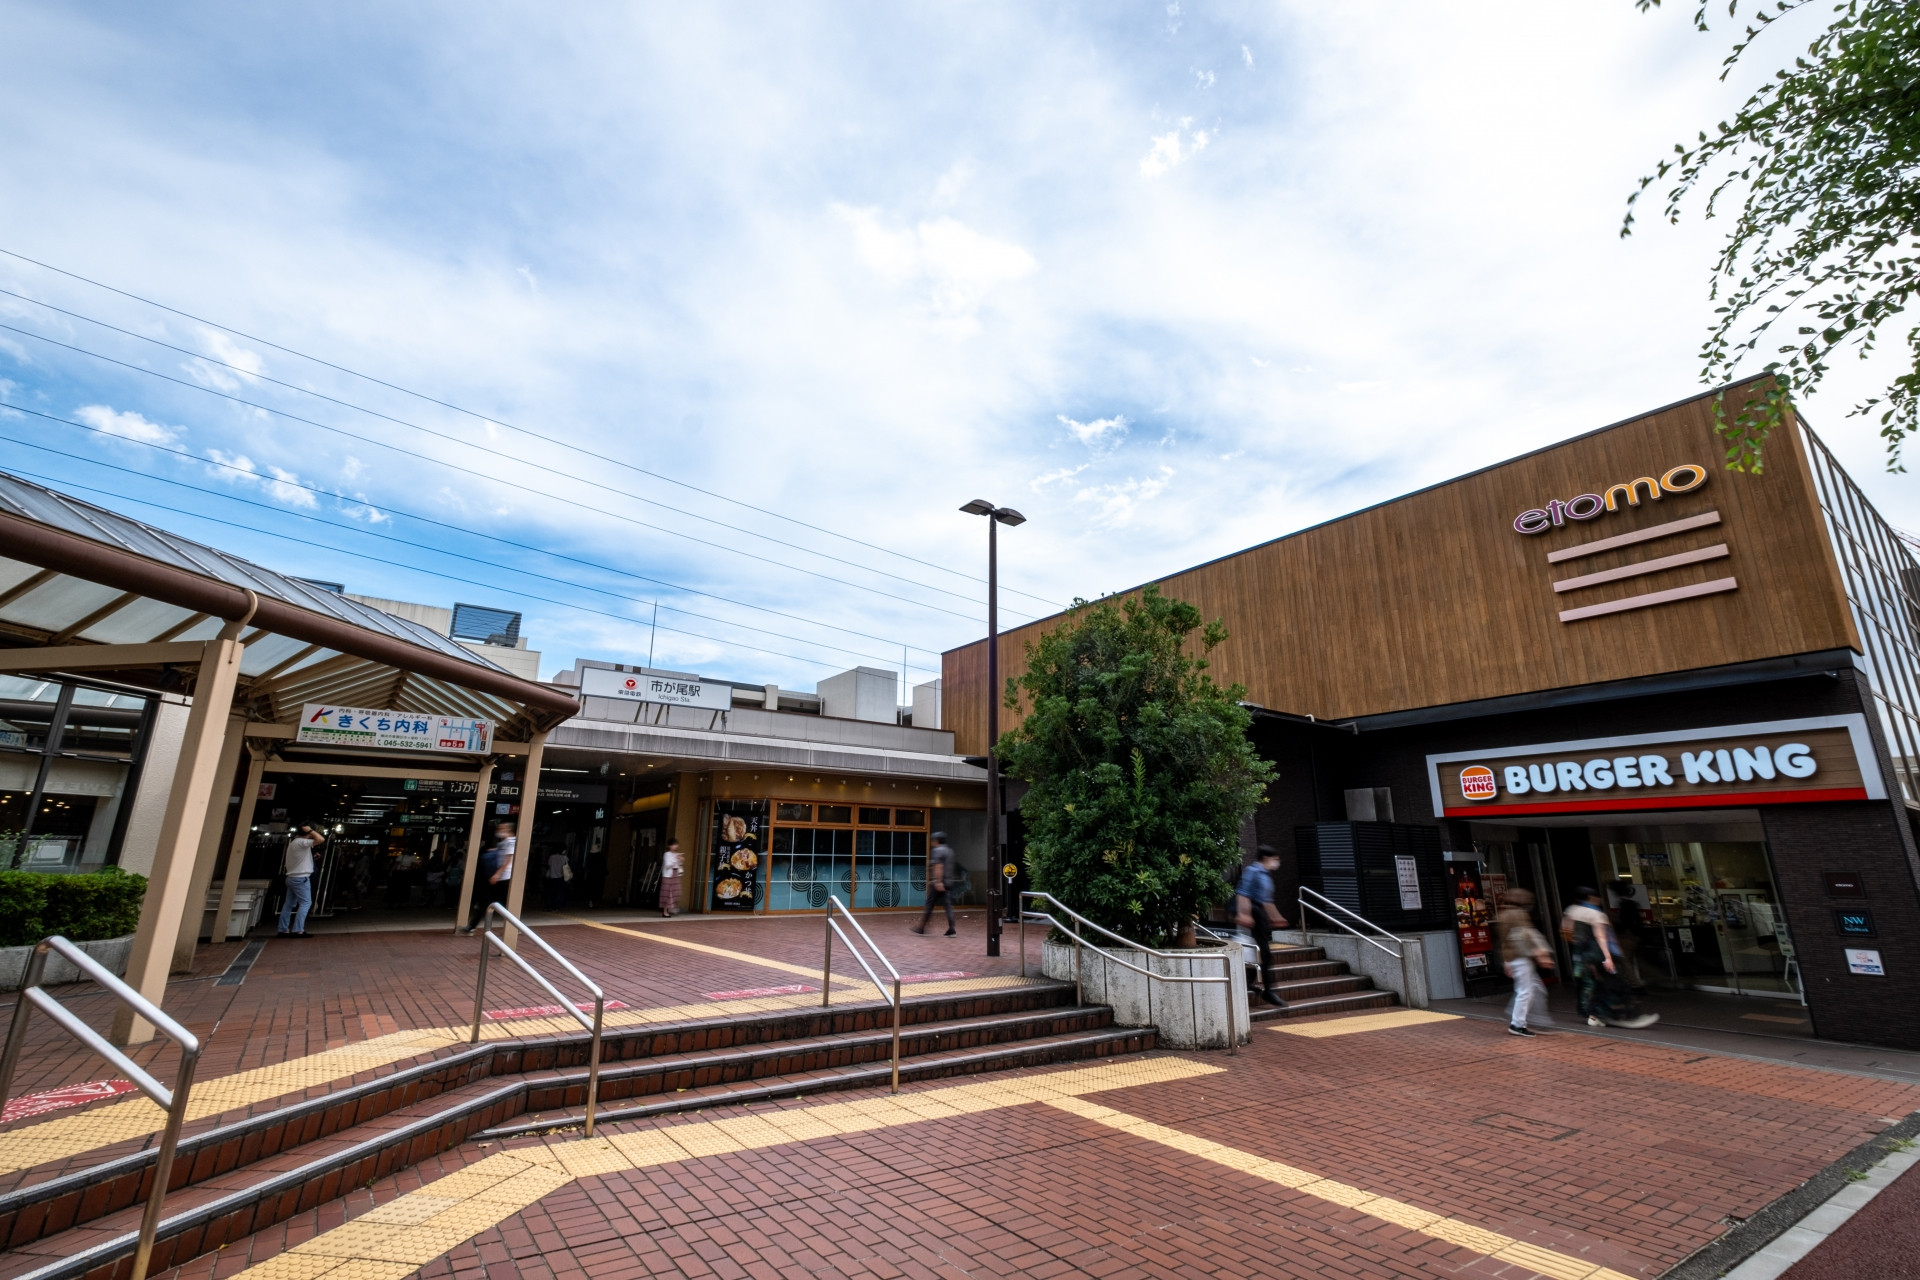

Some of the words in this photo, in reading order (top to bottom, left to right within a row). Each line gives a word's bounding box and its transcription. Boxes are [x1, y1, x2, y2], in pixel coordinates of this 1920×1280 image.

[1513, 463, 1709, 535] etomo
[617, 689, 642, 697] 東急電鉄
[651, 680, 701, 697] 市が尾駅
[658, 693, 679, 702] Ichigao
[338, 714, 429, 735] きくち内科
[383, 739, 433, 749] 045-532-5941
[1503, 754, 1673, 795] BURGER
[1681, 742, 1817, 785] KING
[1462, 775, 1493, 784] BURGER
[500, 786, 519, 795] 西口
[1463, 782, 1494, 793] KING
[1843, 916, 1865, 925] NW
